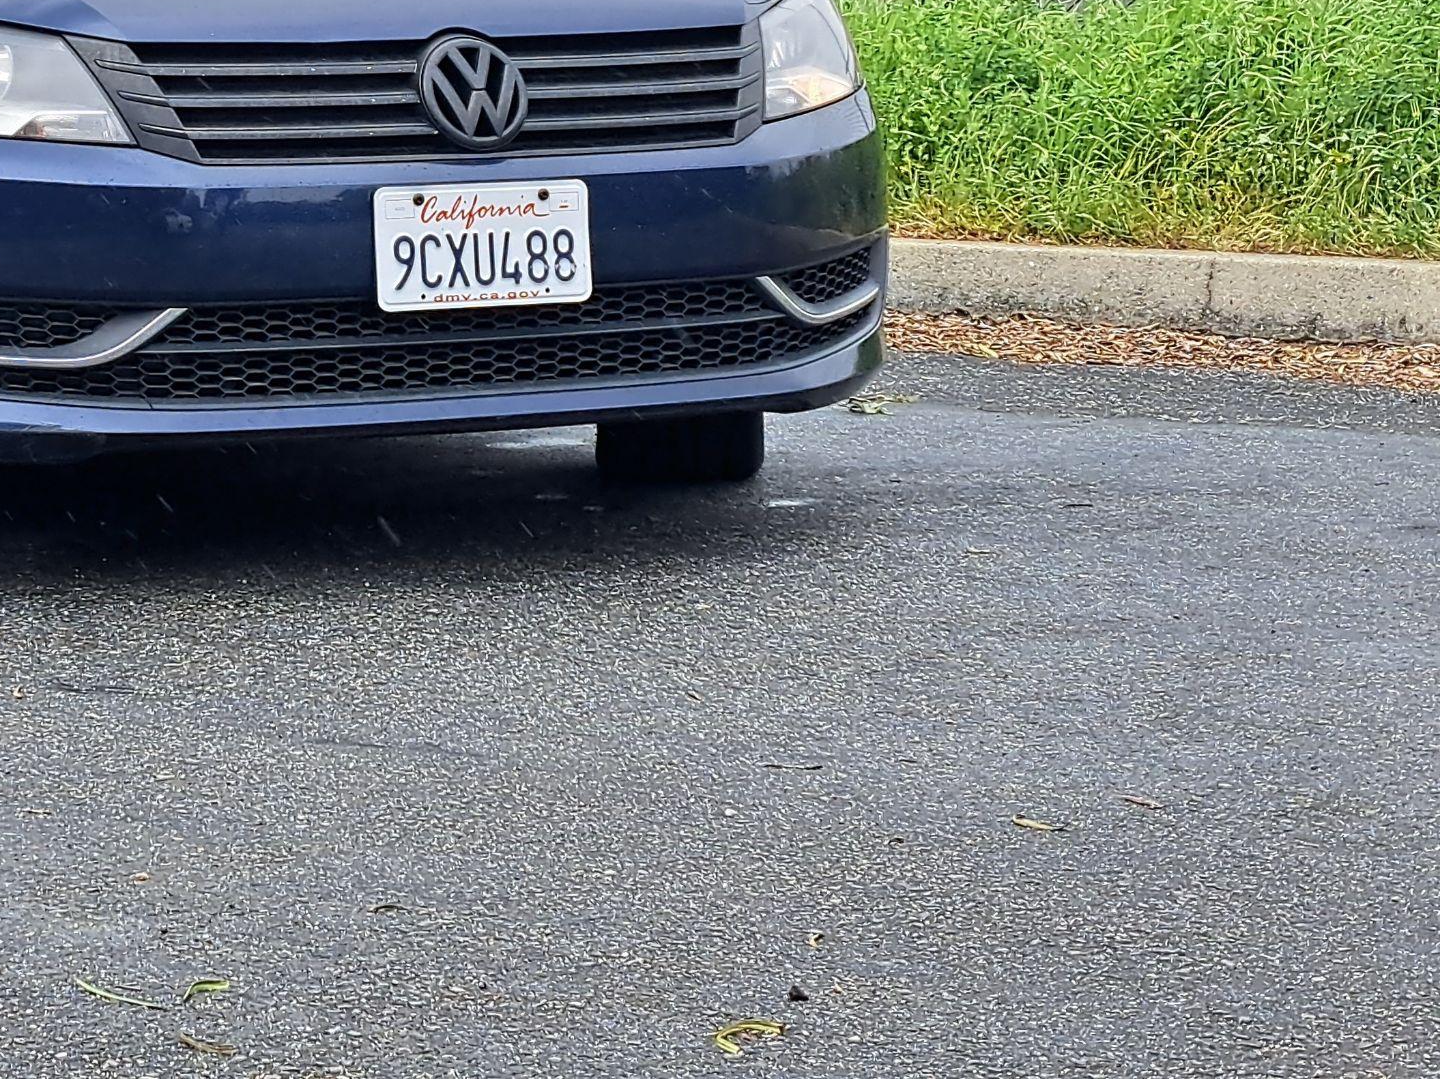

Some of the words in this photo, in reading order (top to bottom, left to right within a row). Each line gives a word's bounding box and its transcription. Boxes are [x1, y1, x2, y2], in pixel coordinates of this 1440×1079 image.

[428, 42, 518, 140] VW
[420, 193, 549, 229] California
[393, 228, 577, 291] 9CXU488
[433, 289, 540, 303] dmv.ca.gov
